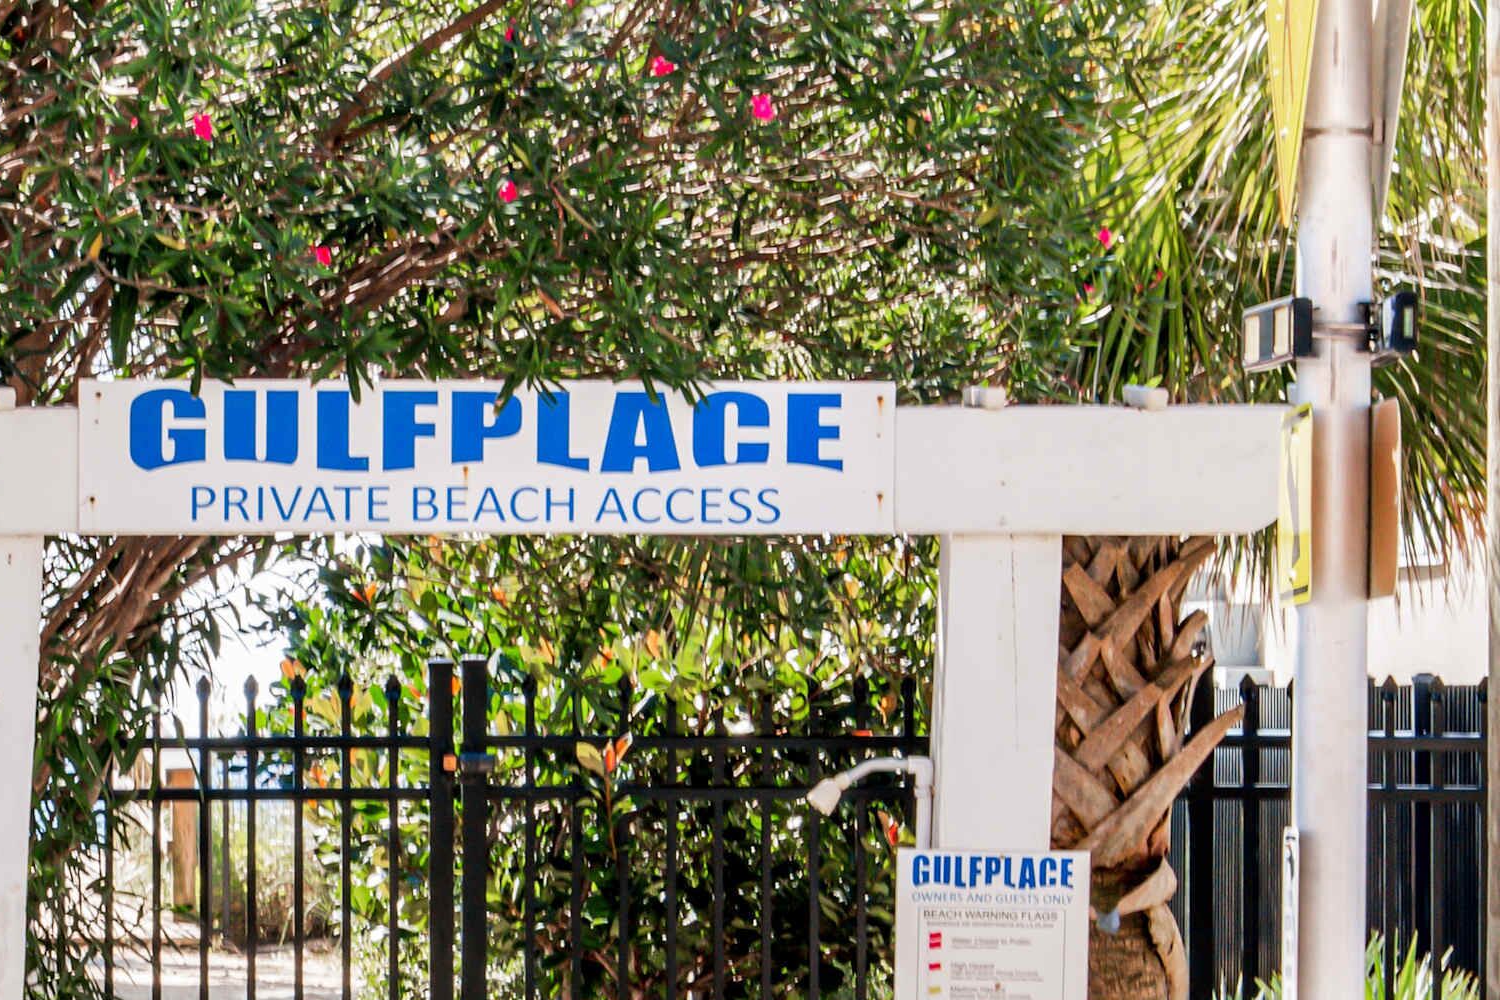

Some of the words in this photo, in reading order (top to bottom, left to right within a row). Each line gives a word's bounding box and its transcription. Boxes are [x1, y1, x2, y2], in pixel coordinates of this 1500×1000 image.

[129, 388, 845, 473] GULFPLACE
[190, 486, 390, 522] PRIVATE
[413, 486, 576, 523] BEACH
[595, 486, 783, 525] ACCESS
[912, 854, 1074, 889] GULFPLACE
[911, 892, 963, 903] OWNERS
[967, 893, 992, 904] AND
[995, 893, 1040, 905] GUESTS
[1043, 894, 1074, 906] ONLY
[923, 909, 962, 919] BEACH
[965, 910, 1018, 920] WARNING
[1021, 911, 1058, 921] FLAGS
